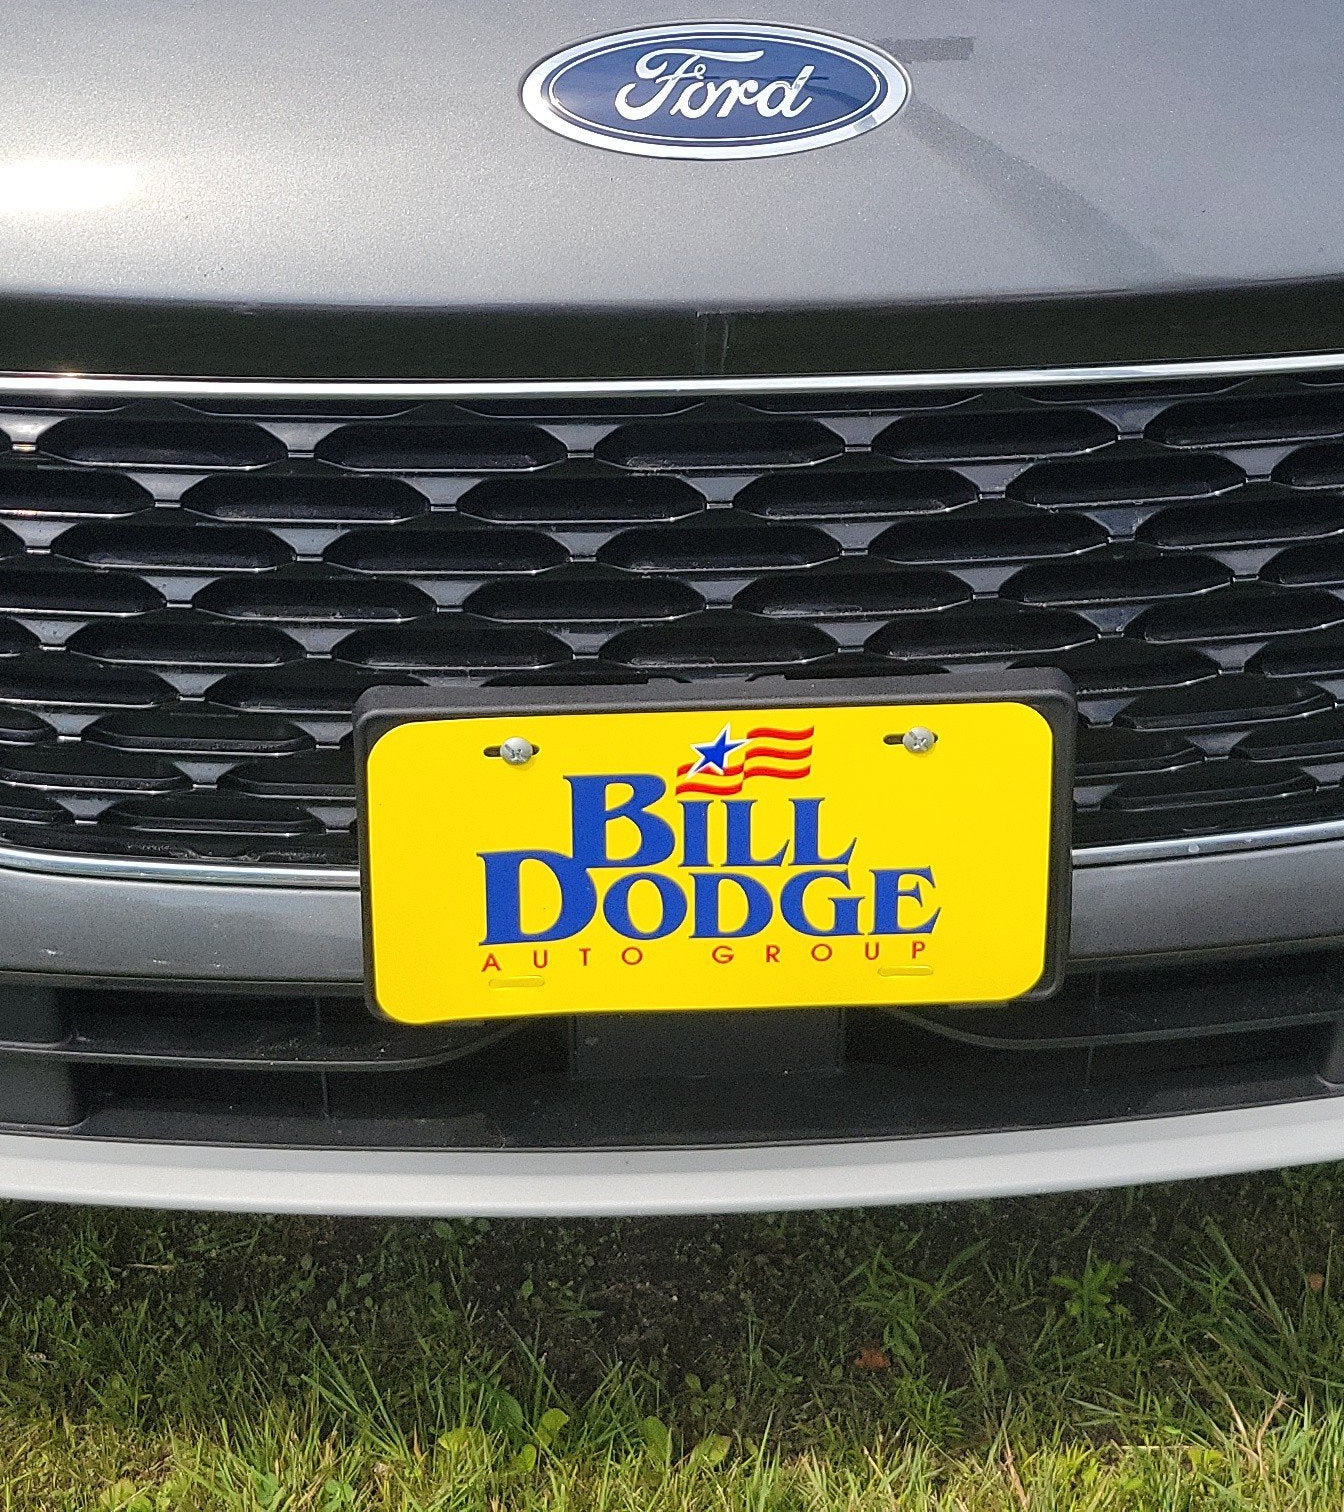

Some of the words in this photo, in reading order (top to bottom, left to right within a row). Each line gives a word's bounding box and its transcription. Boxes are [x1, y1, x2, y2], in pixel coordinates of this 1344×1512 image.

[613, 48, 816, 122] Ford
[562, 772, 857, 869] BILL
[476, 848, 942, 946] DODGE
[480, 946, 644, 972] AUTO
[711, 940, 927, 964] GROUP
